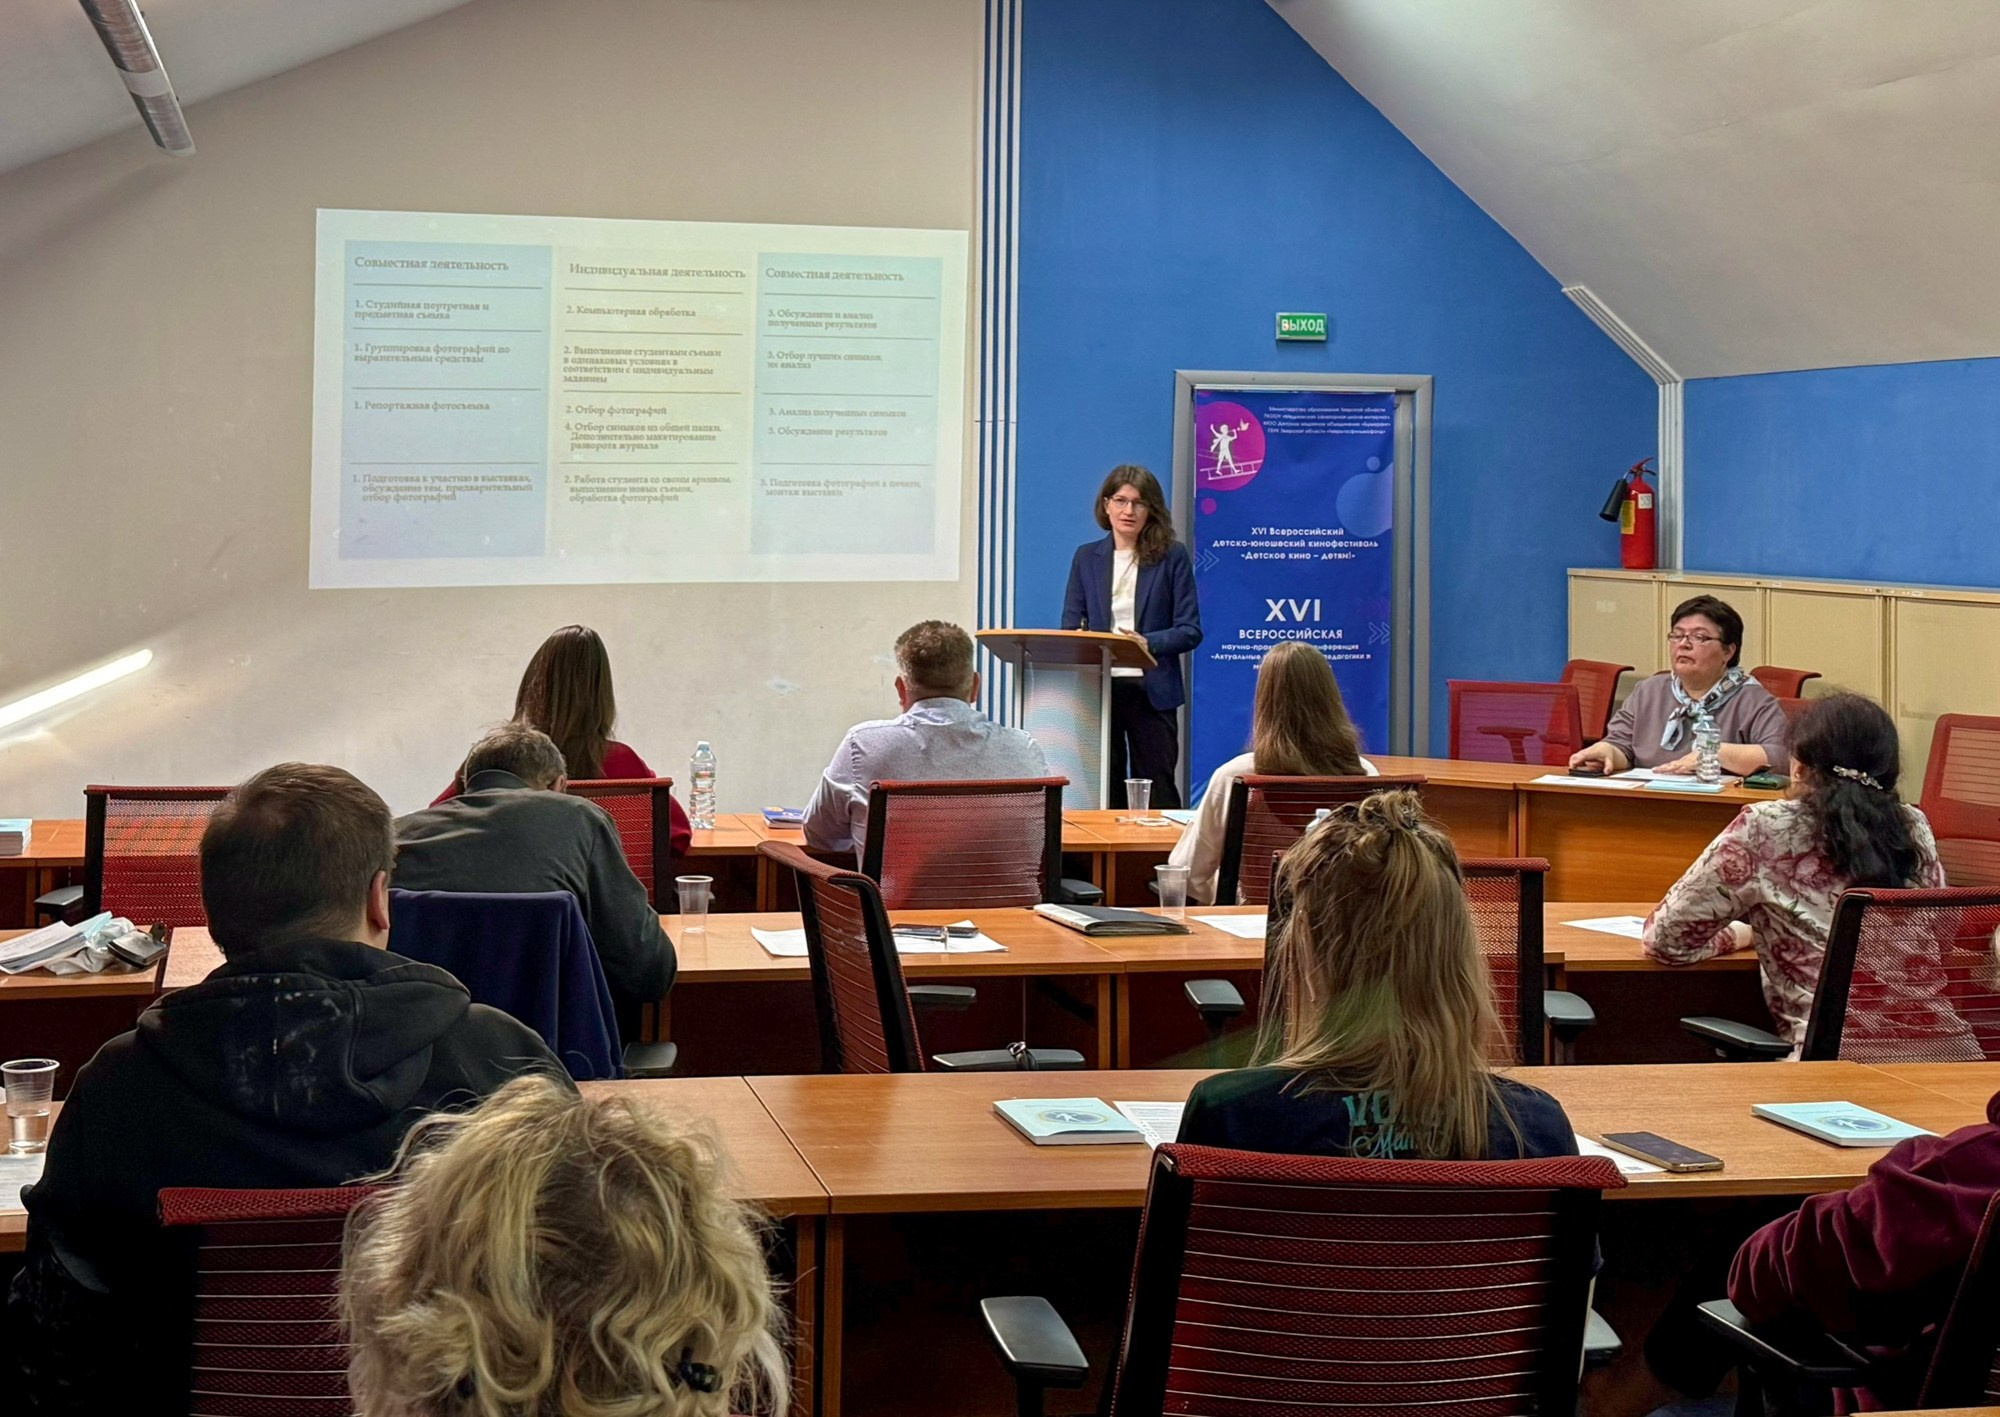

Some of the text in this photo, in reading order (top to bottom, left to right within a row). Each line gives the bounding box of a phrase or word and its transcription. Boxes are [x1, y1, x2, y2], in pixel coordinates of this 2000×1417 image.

[355, 257, 509, 271] Совместная деятельность
[570, 263, 746, 278] Индивидуальная деятельность
[765, 268, 903, 282] Совместная деятельность
[355, 300, 363, 308] 1.
[365, 300, 421, 311] Студийная
[424, 302, 480, 311] портретная
[355, 311, 414, 320] предметная
[566, 306, 696, 318] 2. Компьютерная обработка
[778, 309, 833, 320] Обсуждение
[768, 319, 877, 330] полученных результатов
[1281, 318, 1325, 333] ВЫХОД
[354, 343, 362, 351] 1.
[365, 343, 430, 354] Группировка
[433, 344, 496, 355] фотографий
[563, 346, 722, 357] 2. Выполнение студентами съемки
[354, 354, 484, 364] выразительным средствам
[571, 357, 627, 366] одинаковых
[629, 358, 671, 367] условиях
[777, 351, 805, 362] Отбор
[807, 353, 841, 362] лучших
[768, 361, 811, 369] их анализ
[563, 366, 624, 374] соответствии
[633, 367, 713, 377] индивидуальным
[563, 375, 607, 384] заданием
[354, 401, 490, 412] 1. Репортажная фотосъемка
[566, 405, 667, 417] 2. Отбор фотографий
[778, 408, 811, 417] Анализ
[814, 409, 867, 419] полученных
[565, 423, 573, 431] 4.
[575, 423, 604, 434] Отбор
[660, 423, 690, 432] общей
[778, 427, 833, 437] Обсуждение
[835, 428, 888, 438] результатов
[570, 432, 716, 443] Дополнительно макетирование
[570, 442, 659, 452] разворота журнала
[353, 475, 361, 483] 1.
[363, 474, 420, 483] Подготовка
[430, 476, 472, 485] участию
[575, 475, 605, 484] Работа
[607, 477, 648, 486] студента
[770, 479, 821, 488] Подготовка
[823, 479, 879, 490] фотографий
[362, 484, 421, 494] обсуждение
[446, 484, 532, 494] предварительный
[570, 486, 627, 494] выполнение
[362, 492, 456, 503] отбор фотографий
[570, 493, 679, 503] обработка фотографий
[1252, 527, 1344, 536] XVI Всероссийский
[1212, 540, 1378, 548] детско-юношеский кинофестиваль
[1241, 552, 1286, 560] «Детское
[1321, 551, 1356, 560] детям!»
[1265, 599, 1321, 622] XVI
[1239, 628, 1343, 639] ВСЕРОССИЙСКАЯ
